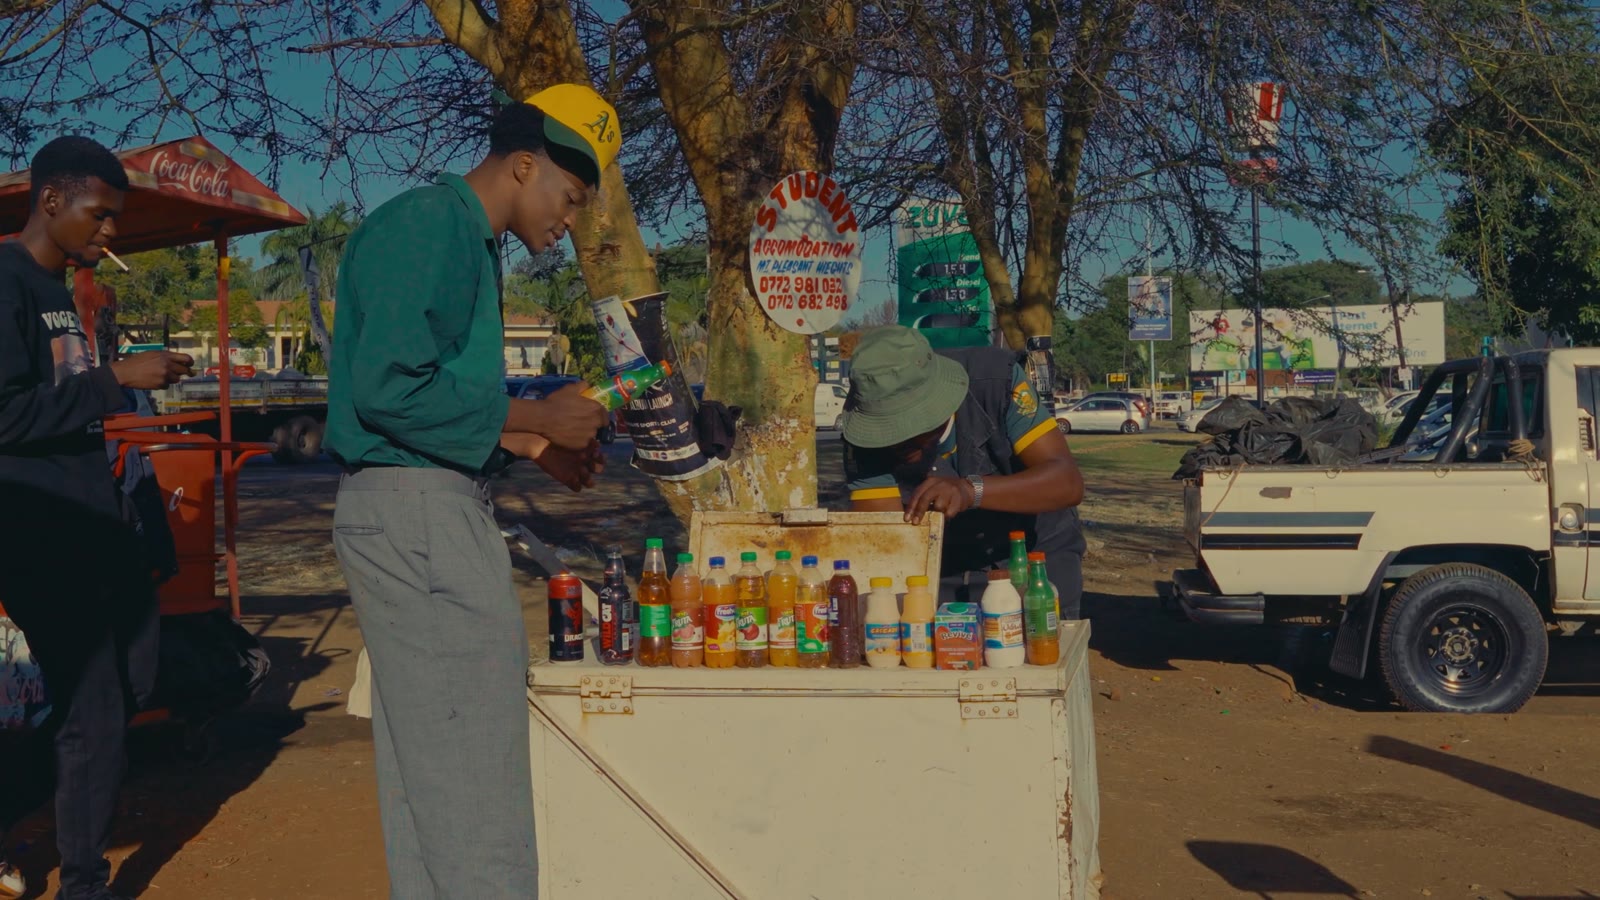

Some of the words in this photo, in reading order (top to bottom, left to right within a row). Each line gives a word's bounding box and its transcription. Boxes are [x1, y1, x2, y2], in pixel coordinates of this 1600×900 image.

[149, 150, 231, 198] Coca-Cola
[757, 171, 857, 234] STUDENT
[753, 238, 855, 258] ACCOMODATION
[772, 260, 814, 274] PLEASANT
[760, 276, 790, 293] 0772
[794, 277, 818, 293] 981
[822, 277, 842, 293] 032
[956, 278, 981, 287] Diesel
[768, 294, 794, 310] 0712
[798, 294, 823, 310] 682
[826, 294, 848, 311] 498
[647, 392, 674, 410] LAUNCH
[601, 603, 612, 622] CAT
[777, 615, 795, 629] FRUT
[602, 622, 613, 649] WILD
